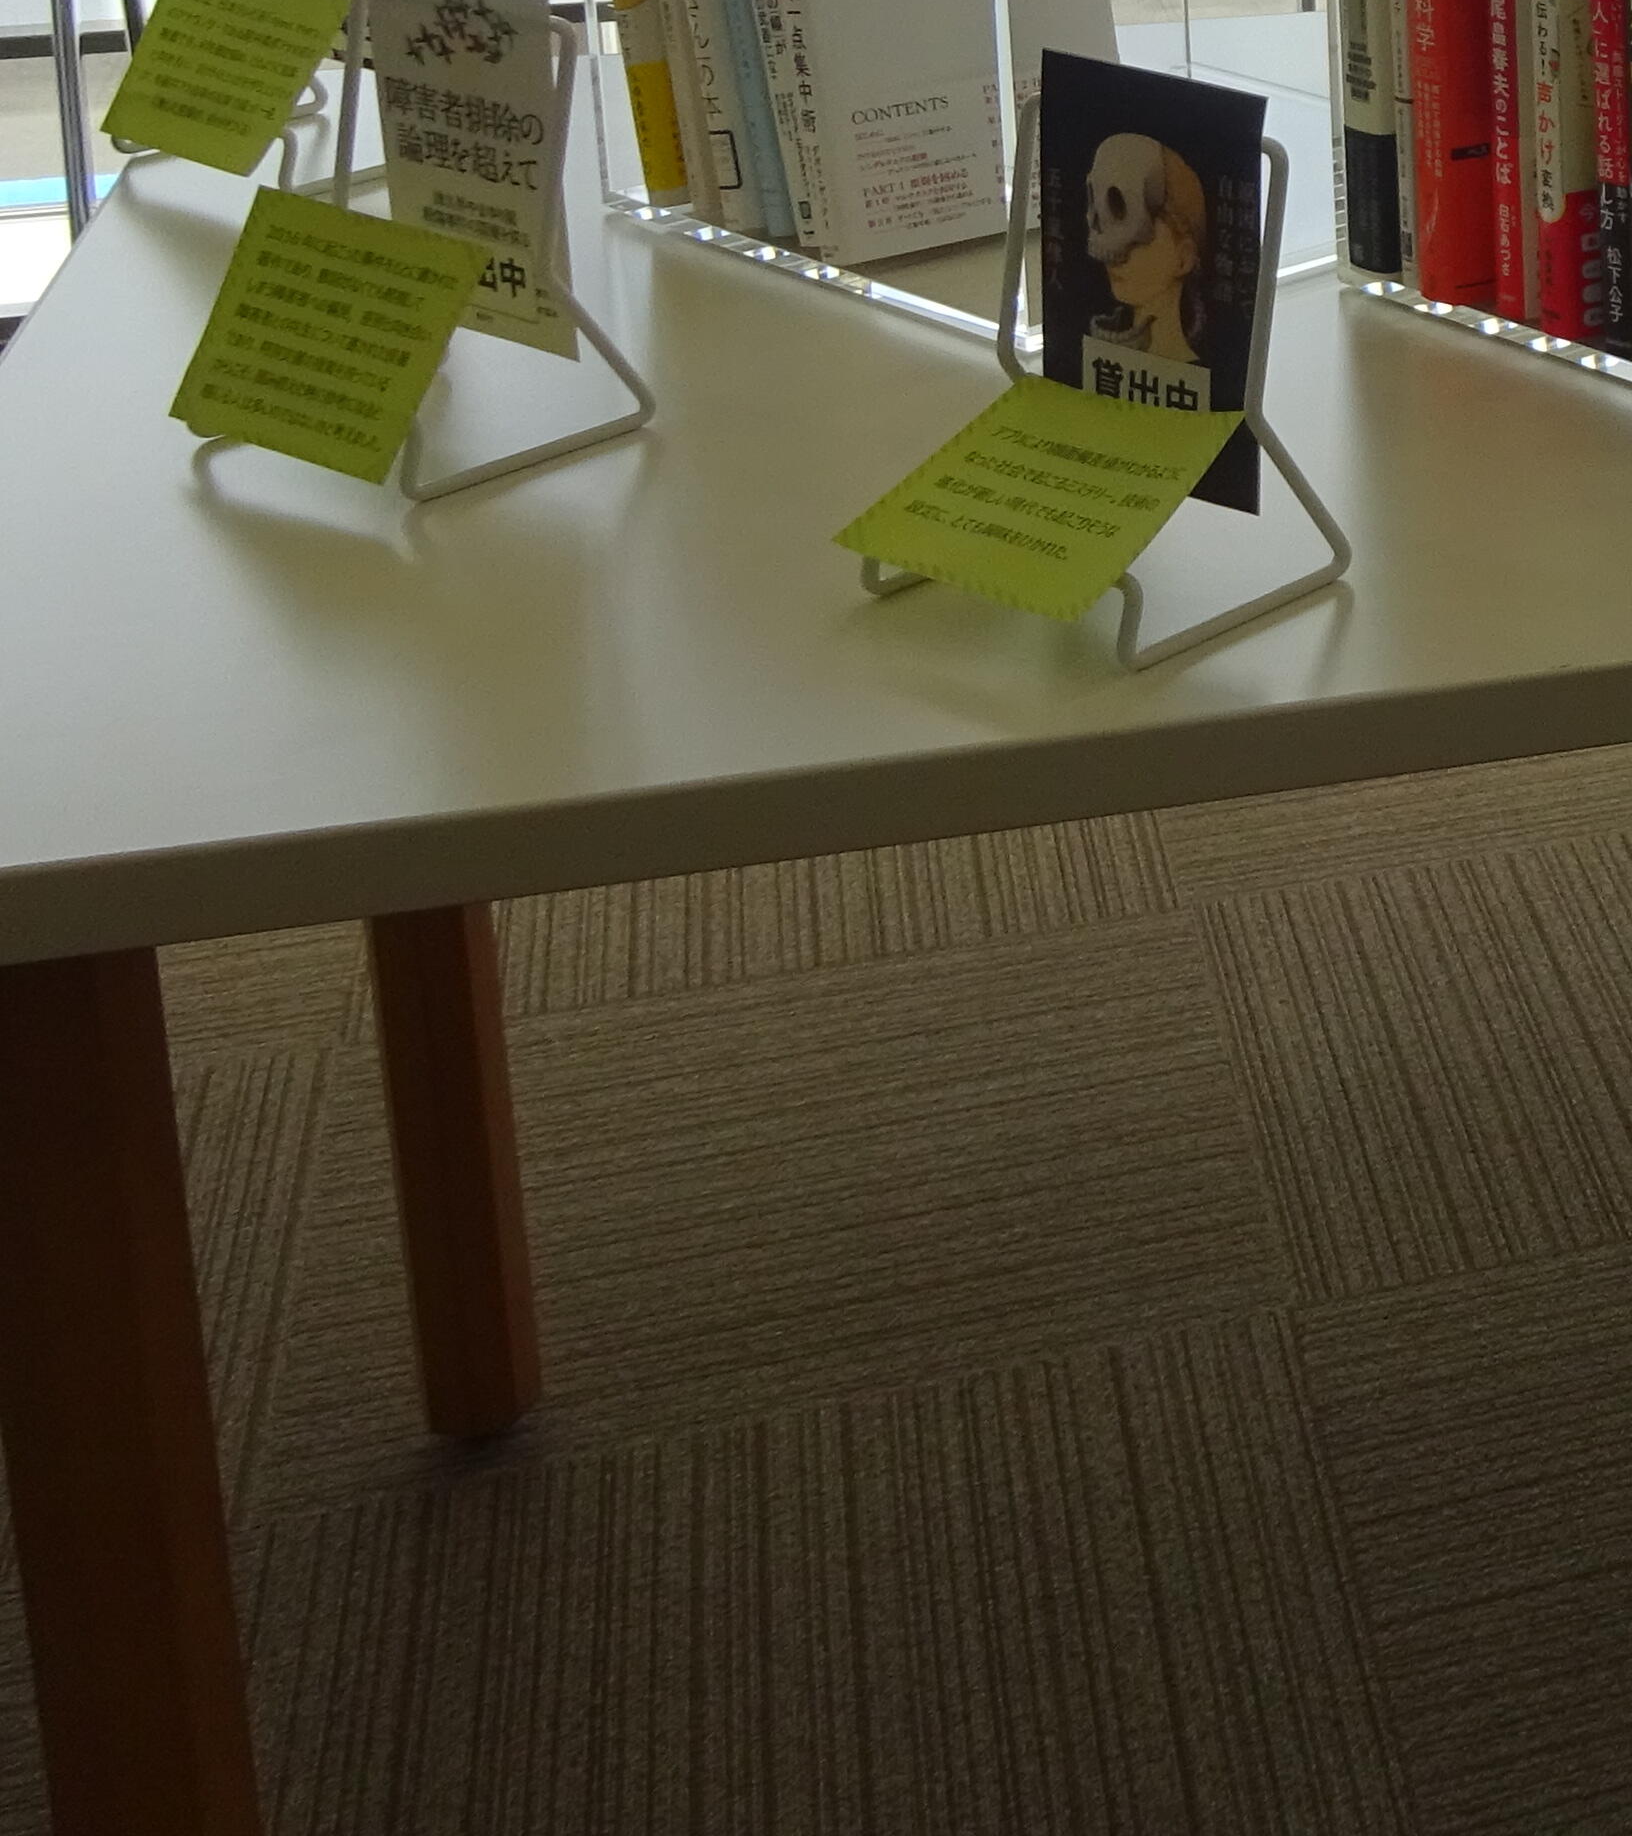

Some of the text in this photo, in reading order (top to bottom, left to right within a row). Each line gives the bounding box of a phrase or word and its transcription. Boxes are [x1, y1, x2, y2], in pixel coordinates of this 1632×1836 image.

[385, 75, 545, 146] 障害者排除の
[851, 95, 949, 126] CONTENTS
[396, 123, 538, 191] 論理を超えて
[1606, 244, 1624, 324] 松下公子
